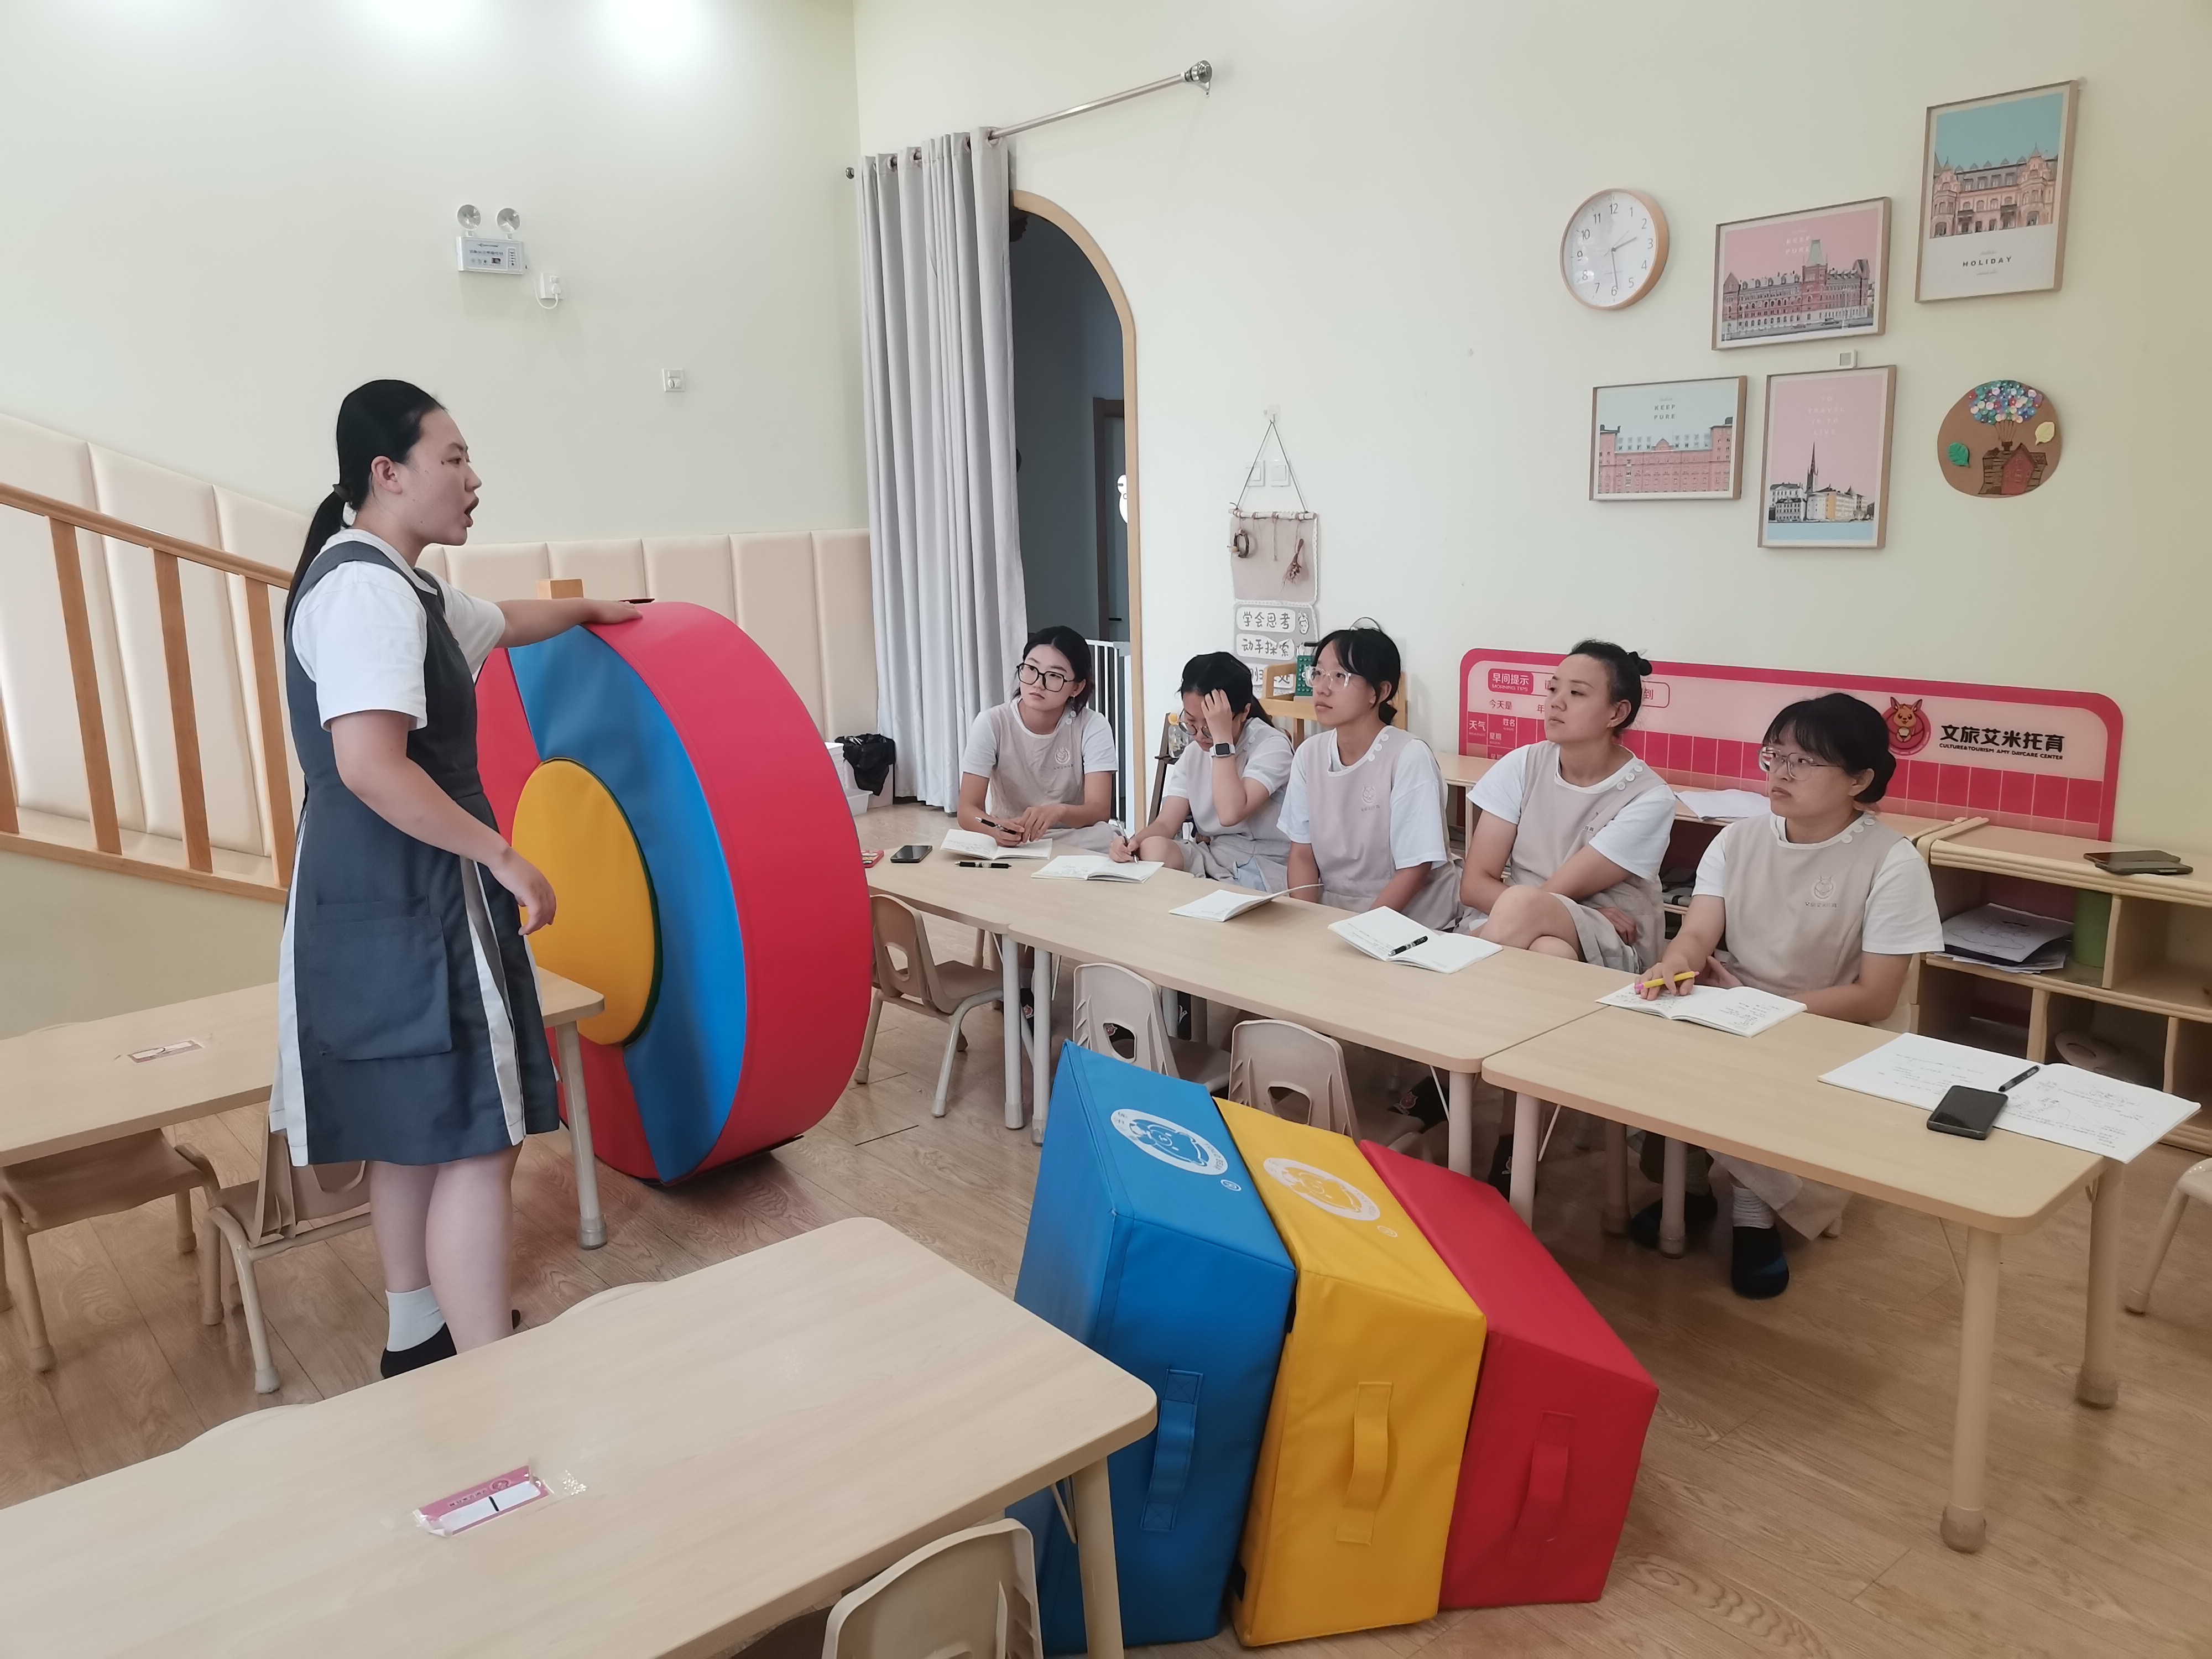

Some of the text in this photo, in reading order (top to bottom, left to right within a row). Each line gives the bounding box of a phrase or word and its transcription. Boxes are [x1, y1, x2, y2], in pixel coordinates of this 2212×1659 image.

[1609, 203, 1618, 215] 12
[1629, 207, 1633, 217] 1
[1593, 213, 1601, 225] 11
[1641, 218, 1647, 229] 2
[1581, 228, 1590, 240] 10
[1647, 238, 1653, 249] 3
[1577, 251, 1583, 261] 9
[1963, 256, 2011, 267] HOLIDAY
[1641, 260, 1647, 270] 4
[1582, 270, 1588, 280] 8
[1594, 283, 1600, 293] 7
[1628, 277, 1634, 288] 5
[1611, 285, 1618, 296] 6
[1243, 611, 1290, 629] 学会思考
[1492, 672, 1529, 686] 早间提示
[1489, 699, 1512, 711] 今天是
[1469, 720, 1486, 731] 天气
[1939, 724, 2065, 753] 文旅艾米托育
[1939, 743, 1994, 753] CULTURE&TOURISM
